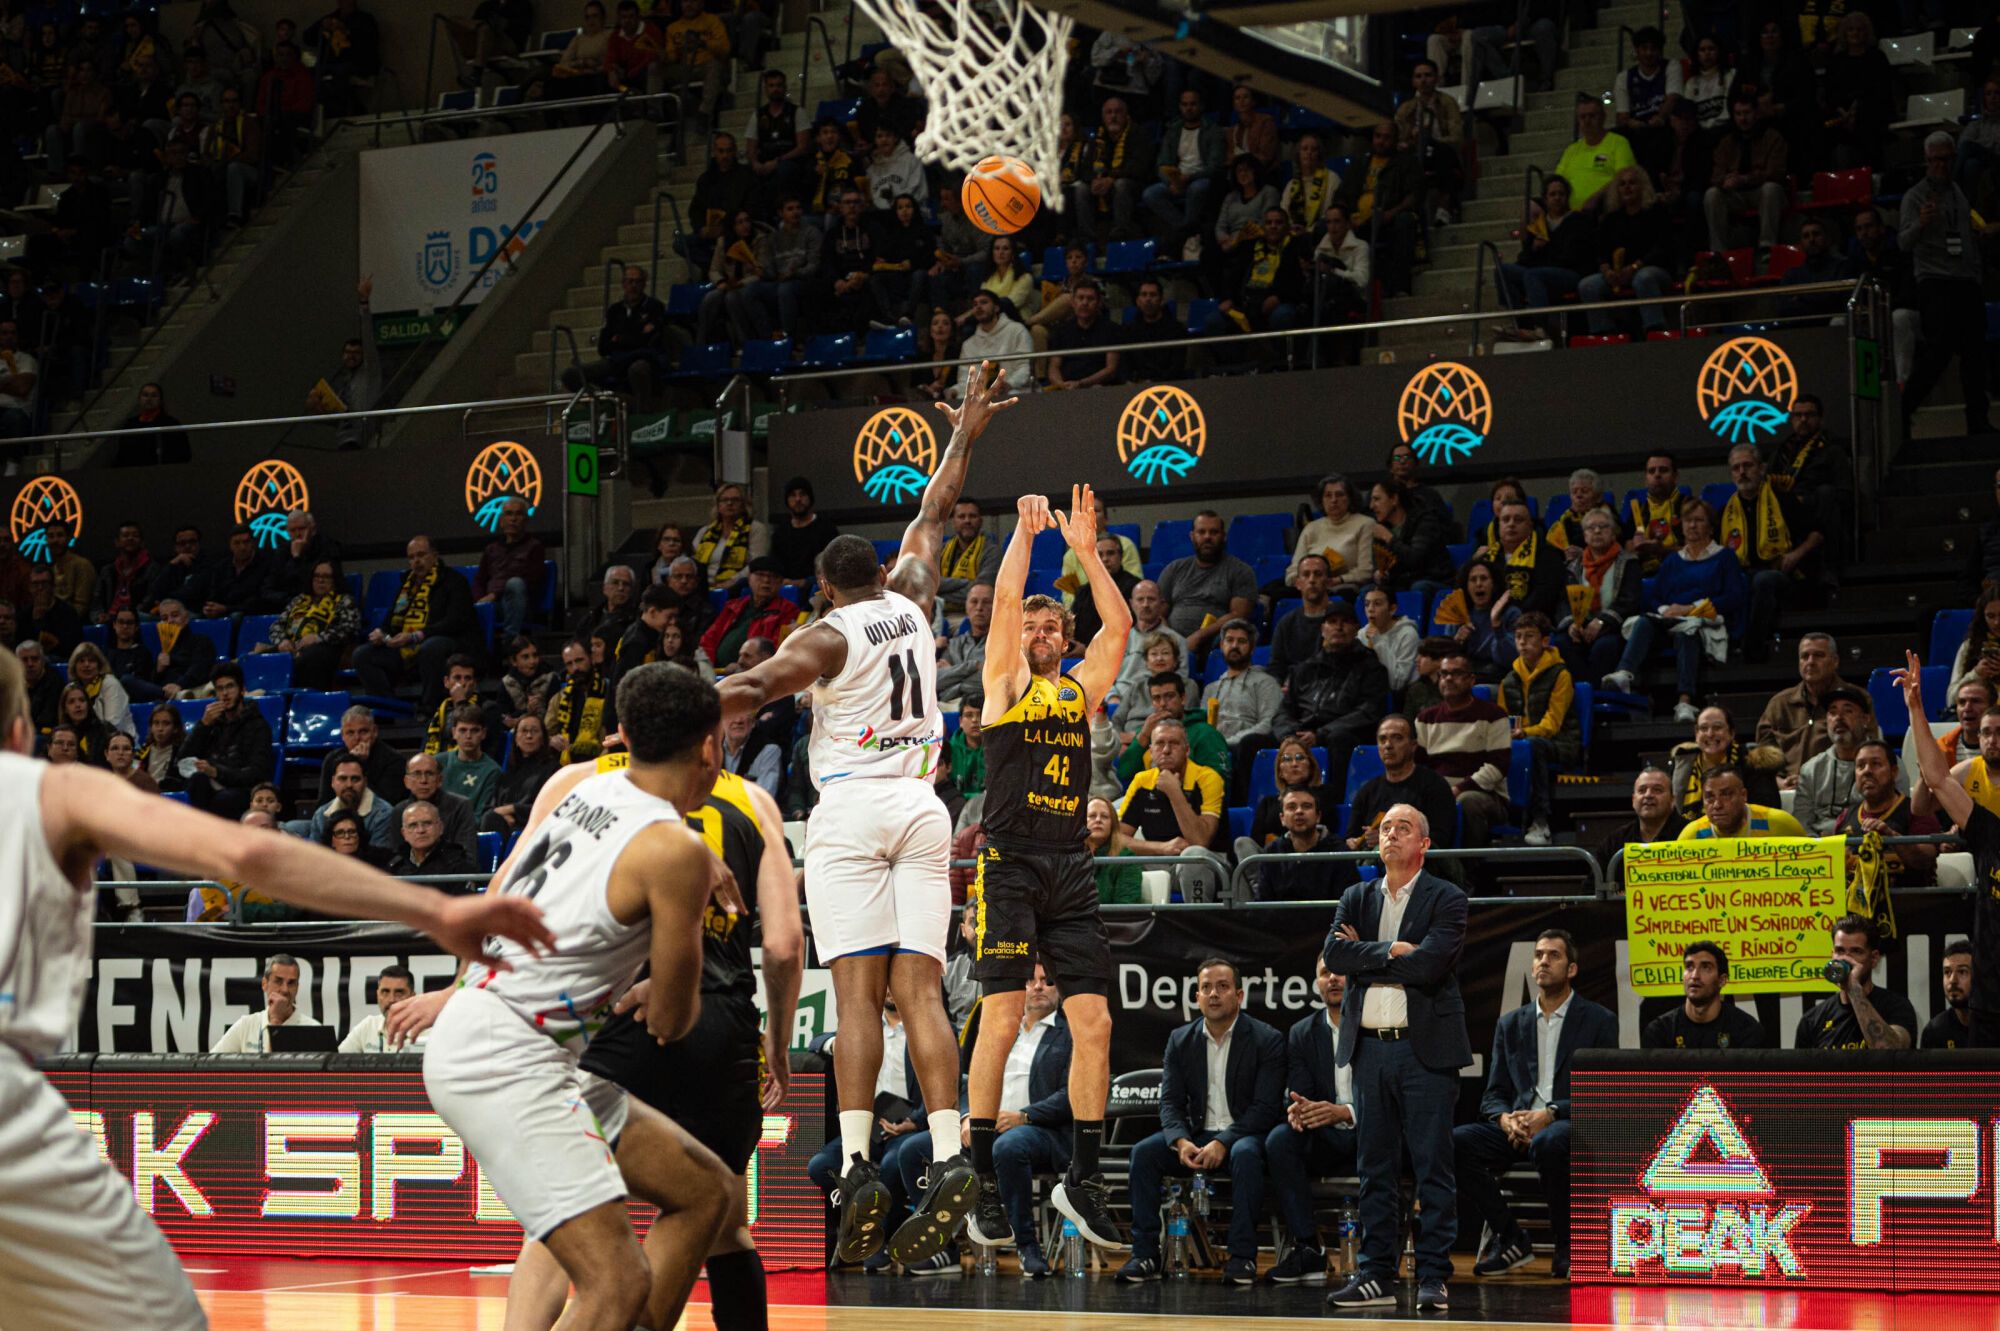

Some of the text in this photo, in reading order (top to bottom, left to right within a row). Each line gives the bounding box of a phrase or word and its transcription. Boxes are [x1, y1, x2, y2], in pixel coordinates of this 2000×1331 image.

[379, 320, 433, 340] SALIDA
[1863, 350, 1874, 387] P
[888, 648, 925, 721] 11
[1024, 728, 1041, 743] LA
[1043, 753, 1070, 786] 42
[1774, 859, 1826, 884] League
[1633, 889, 1644, 910] A
[1649, 892, 1702, 912] VECES
[1810, 889, 1835, 907] ES
[1731, 964, 1788, 980] TENERIFE
[1118, 963, 1327, 1022] Deprtes
[1610, 1200, 1812, 1279] PEAK
